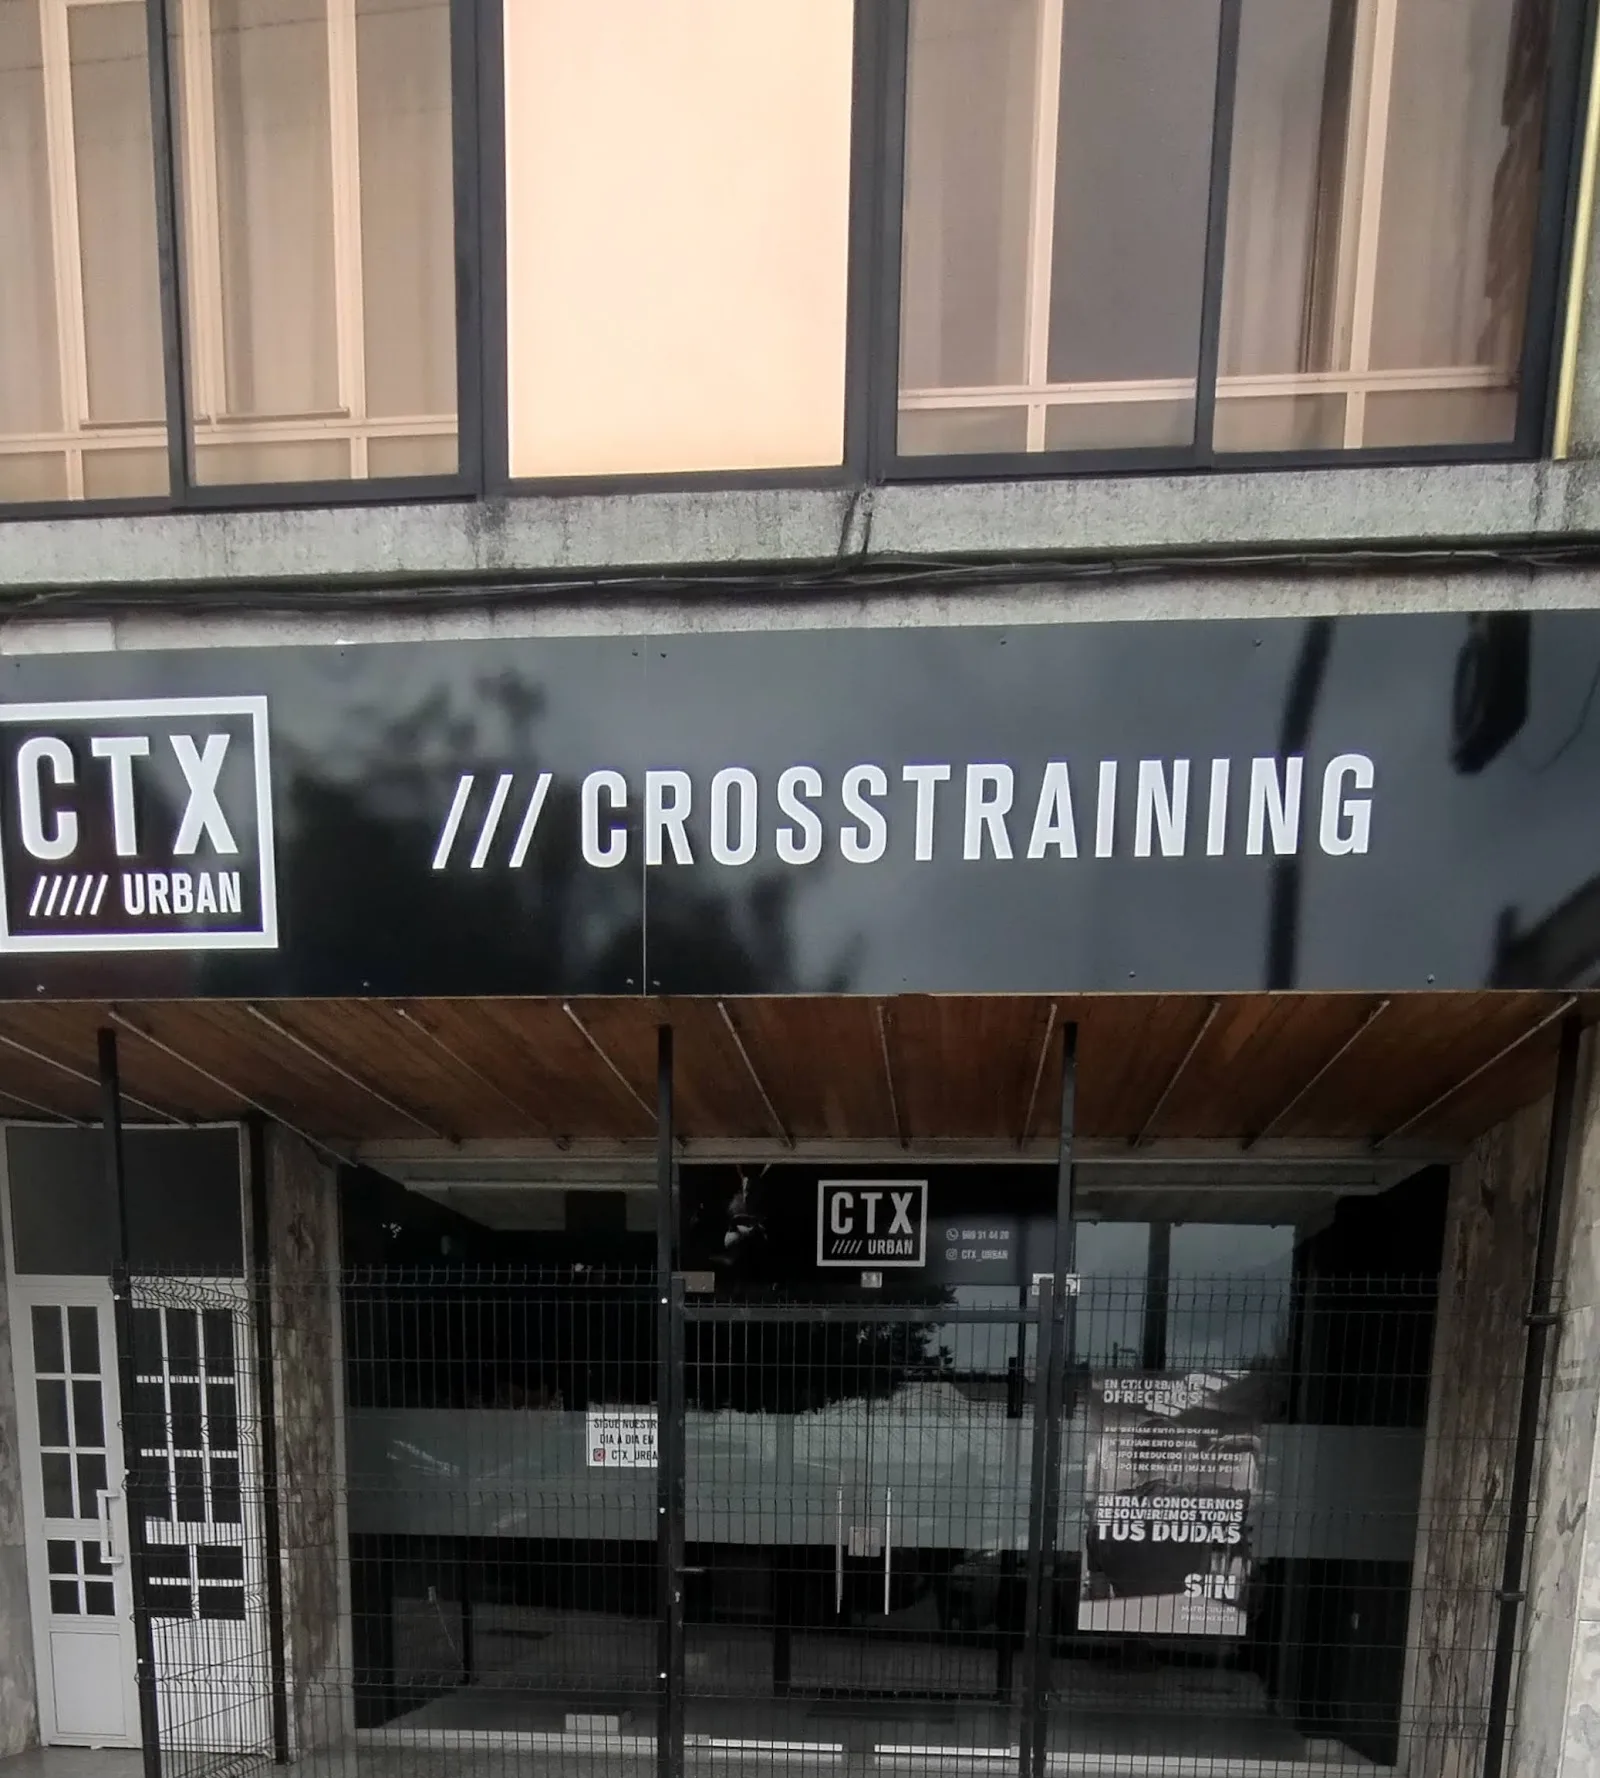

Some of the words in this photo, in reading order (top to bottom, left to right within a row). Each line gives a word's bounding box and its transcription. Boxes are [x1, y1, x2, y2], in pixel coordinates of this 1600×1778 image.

[17, 733, 240, 860] CTX
[581, 752, 1375, 868] CROSSTRAINING
[123, 871, 242, 916] URBAN
[831, 1191, 914, 1235] CTX
[868, 1239, 913, 1255] URBAN
[1104, 1379, 1118, 1389] EN
[1121, 1379, 1141, 1390] CTX
[1103, 1390, 1200, 1404] OFRECEMOS
[593, 1418, 620, 1429] SIGUE
[622, 1419, 658, 1429] NUESTR
[600, 1434, 613, 1445] DIA
[625, 1434, 640, 1445] DIA
[611, 1450, 659, 1463] CTX_URBA
[1097, 1496, 1139, 1508] ENTRA
[1141, 1497, 1151, 1508] A
[1152, 1497, 1244, 1510] CONOCERNOS
[1097, 1508, 1197, 1521] RESOLVEREMOS
[1199, 1510, 1243, 1522] TODAS
[1097, 1519, 1146, 1541] TUS
[1152, 1521, 1242, 1545] DUDAS
[1183, 1573, 1236, 1599] SIN
